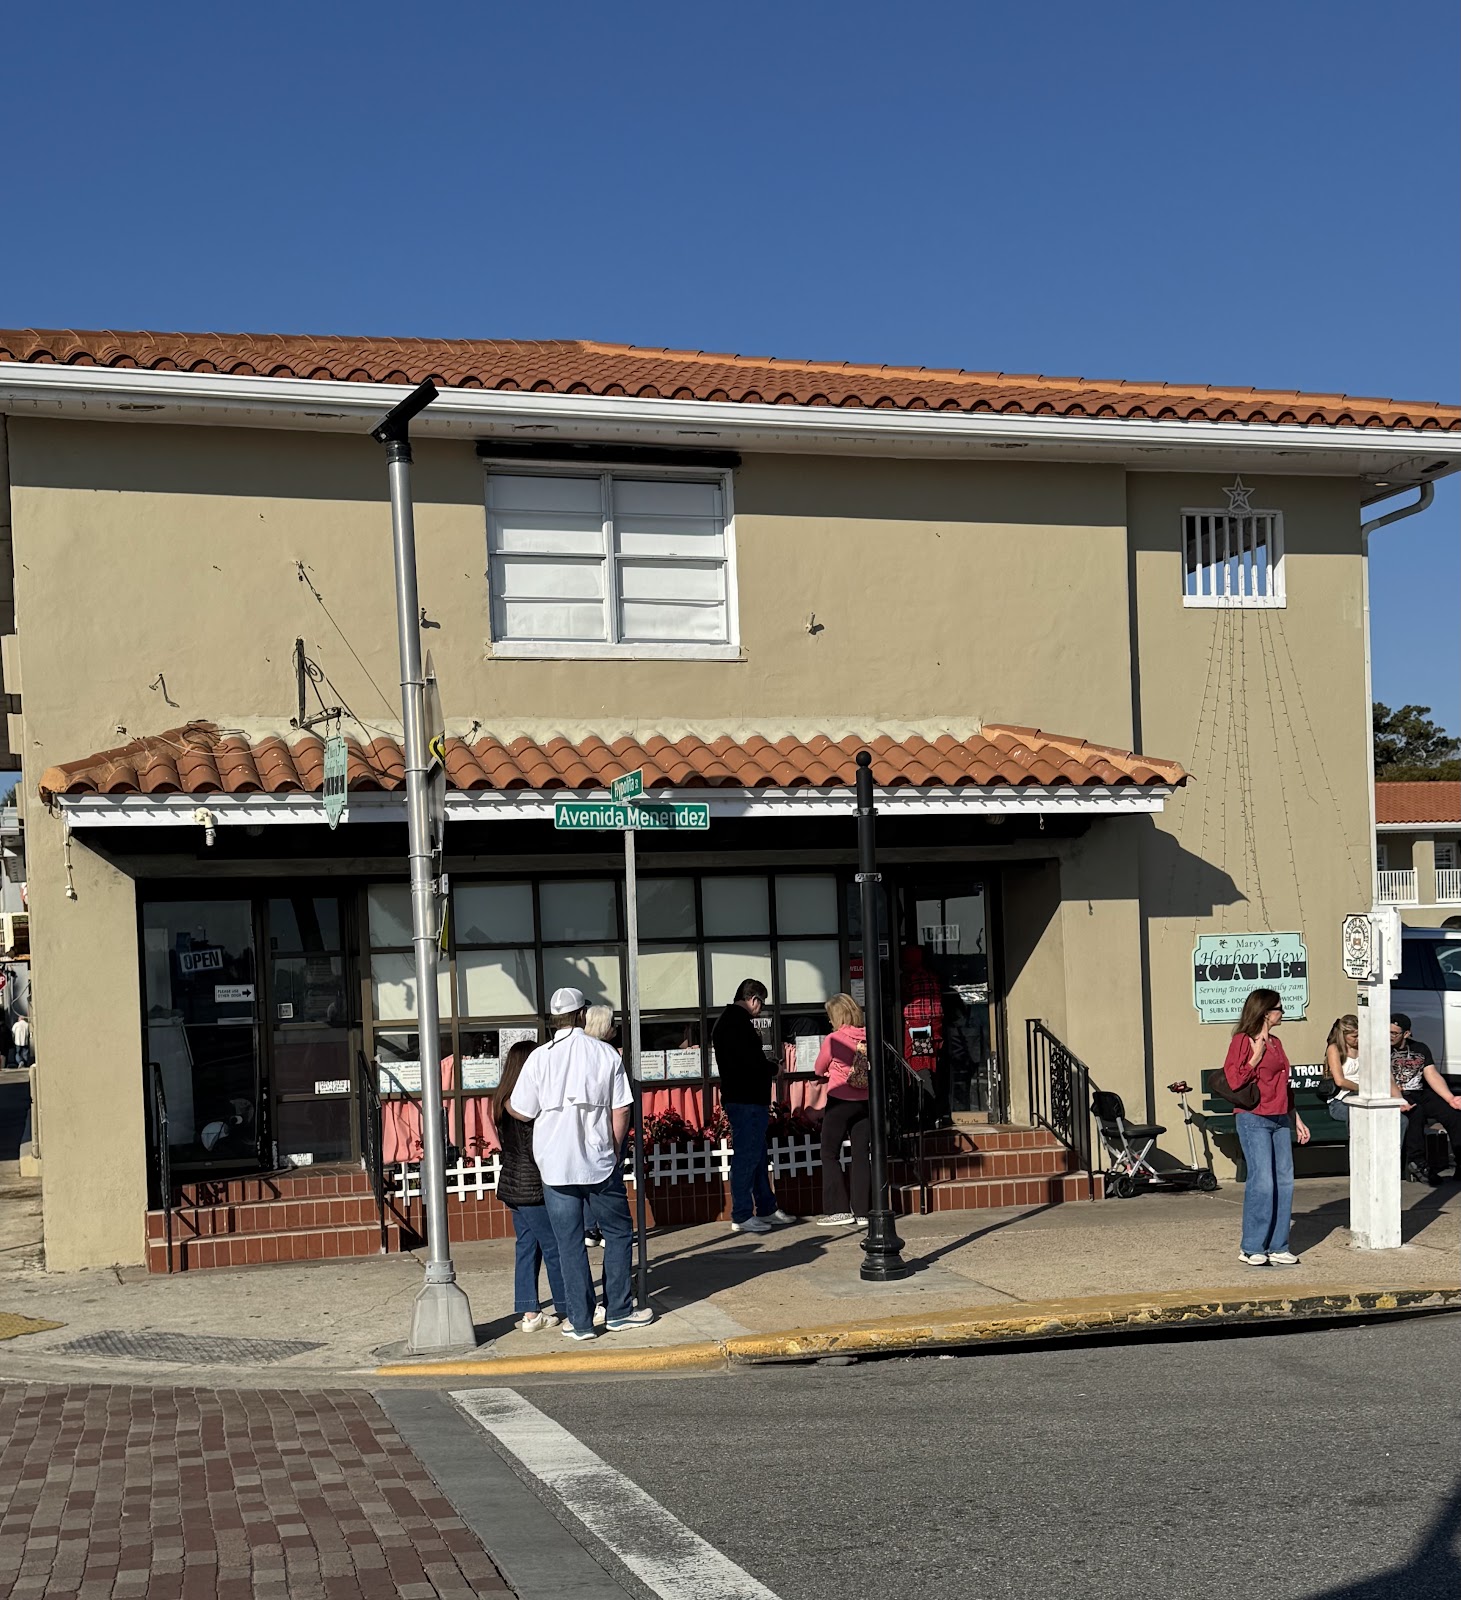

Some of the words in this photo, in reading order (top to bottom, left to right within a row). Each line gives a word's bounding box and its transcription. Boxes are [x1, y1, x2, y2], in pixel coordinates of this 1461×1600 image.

[559, 807, 625, 826] Avenida
[627, 807, 706, 826] Menendez
[1236, 939, 1264, 950] Mary's
[184, 951, 220, 970] OPEN
[1200, 949, 1259, 965] Harbor
[1262, 948, 1303, 963] View
[1205, 962, 1293, 981] CAFE
[1199, 986, 1227, 995] Serving
[1294, 1065, 1324, 1076] TROLL
[1304, 1078, 1321, 1088] Bes
